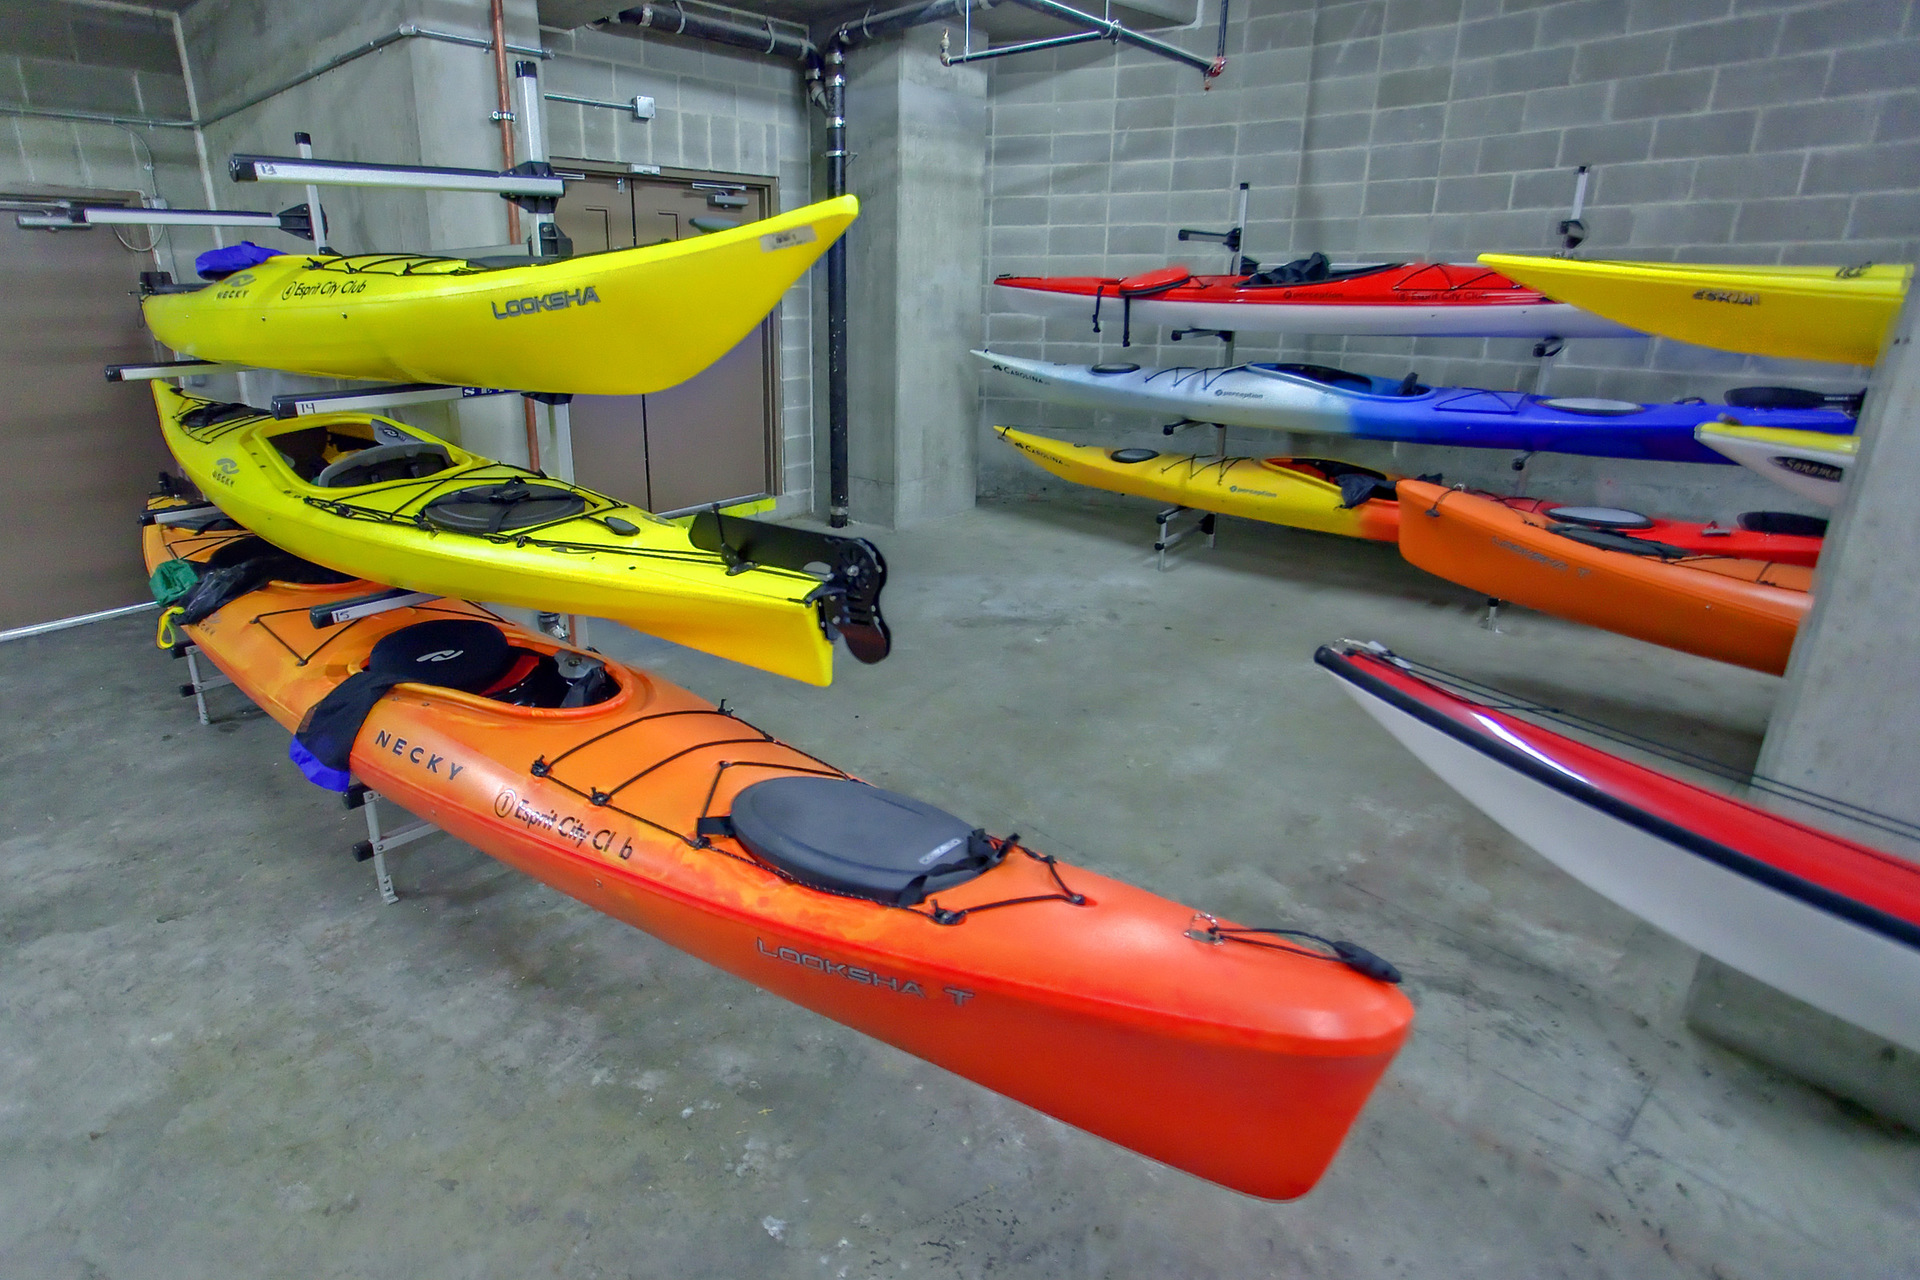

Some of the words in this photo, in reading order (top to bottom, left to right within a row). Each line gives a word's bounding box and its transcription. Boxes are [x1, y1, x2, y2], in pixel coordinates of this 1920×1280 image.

[294, 282, 321, 299] Esprit
[320, 282, 339, 298] City
[341, 280, 367, 294] Club
[491, 285, 601, 320] LOOKSHA
[1441, 290, 1461, 301] City
[301, 402, 315, 414] 14
[336, 610, 349, 621] 15
[375, 730, 464, 781] NECKY
[515, 799, 558, 831] Esprit
[558, 815, 591, 848] City
[592, 829, 633, 861] Clb
[757, 937, 926, 998] LOOKSHA
[943, 985, 975, 1006] T
